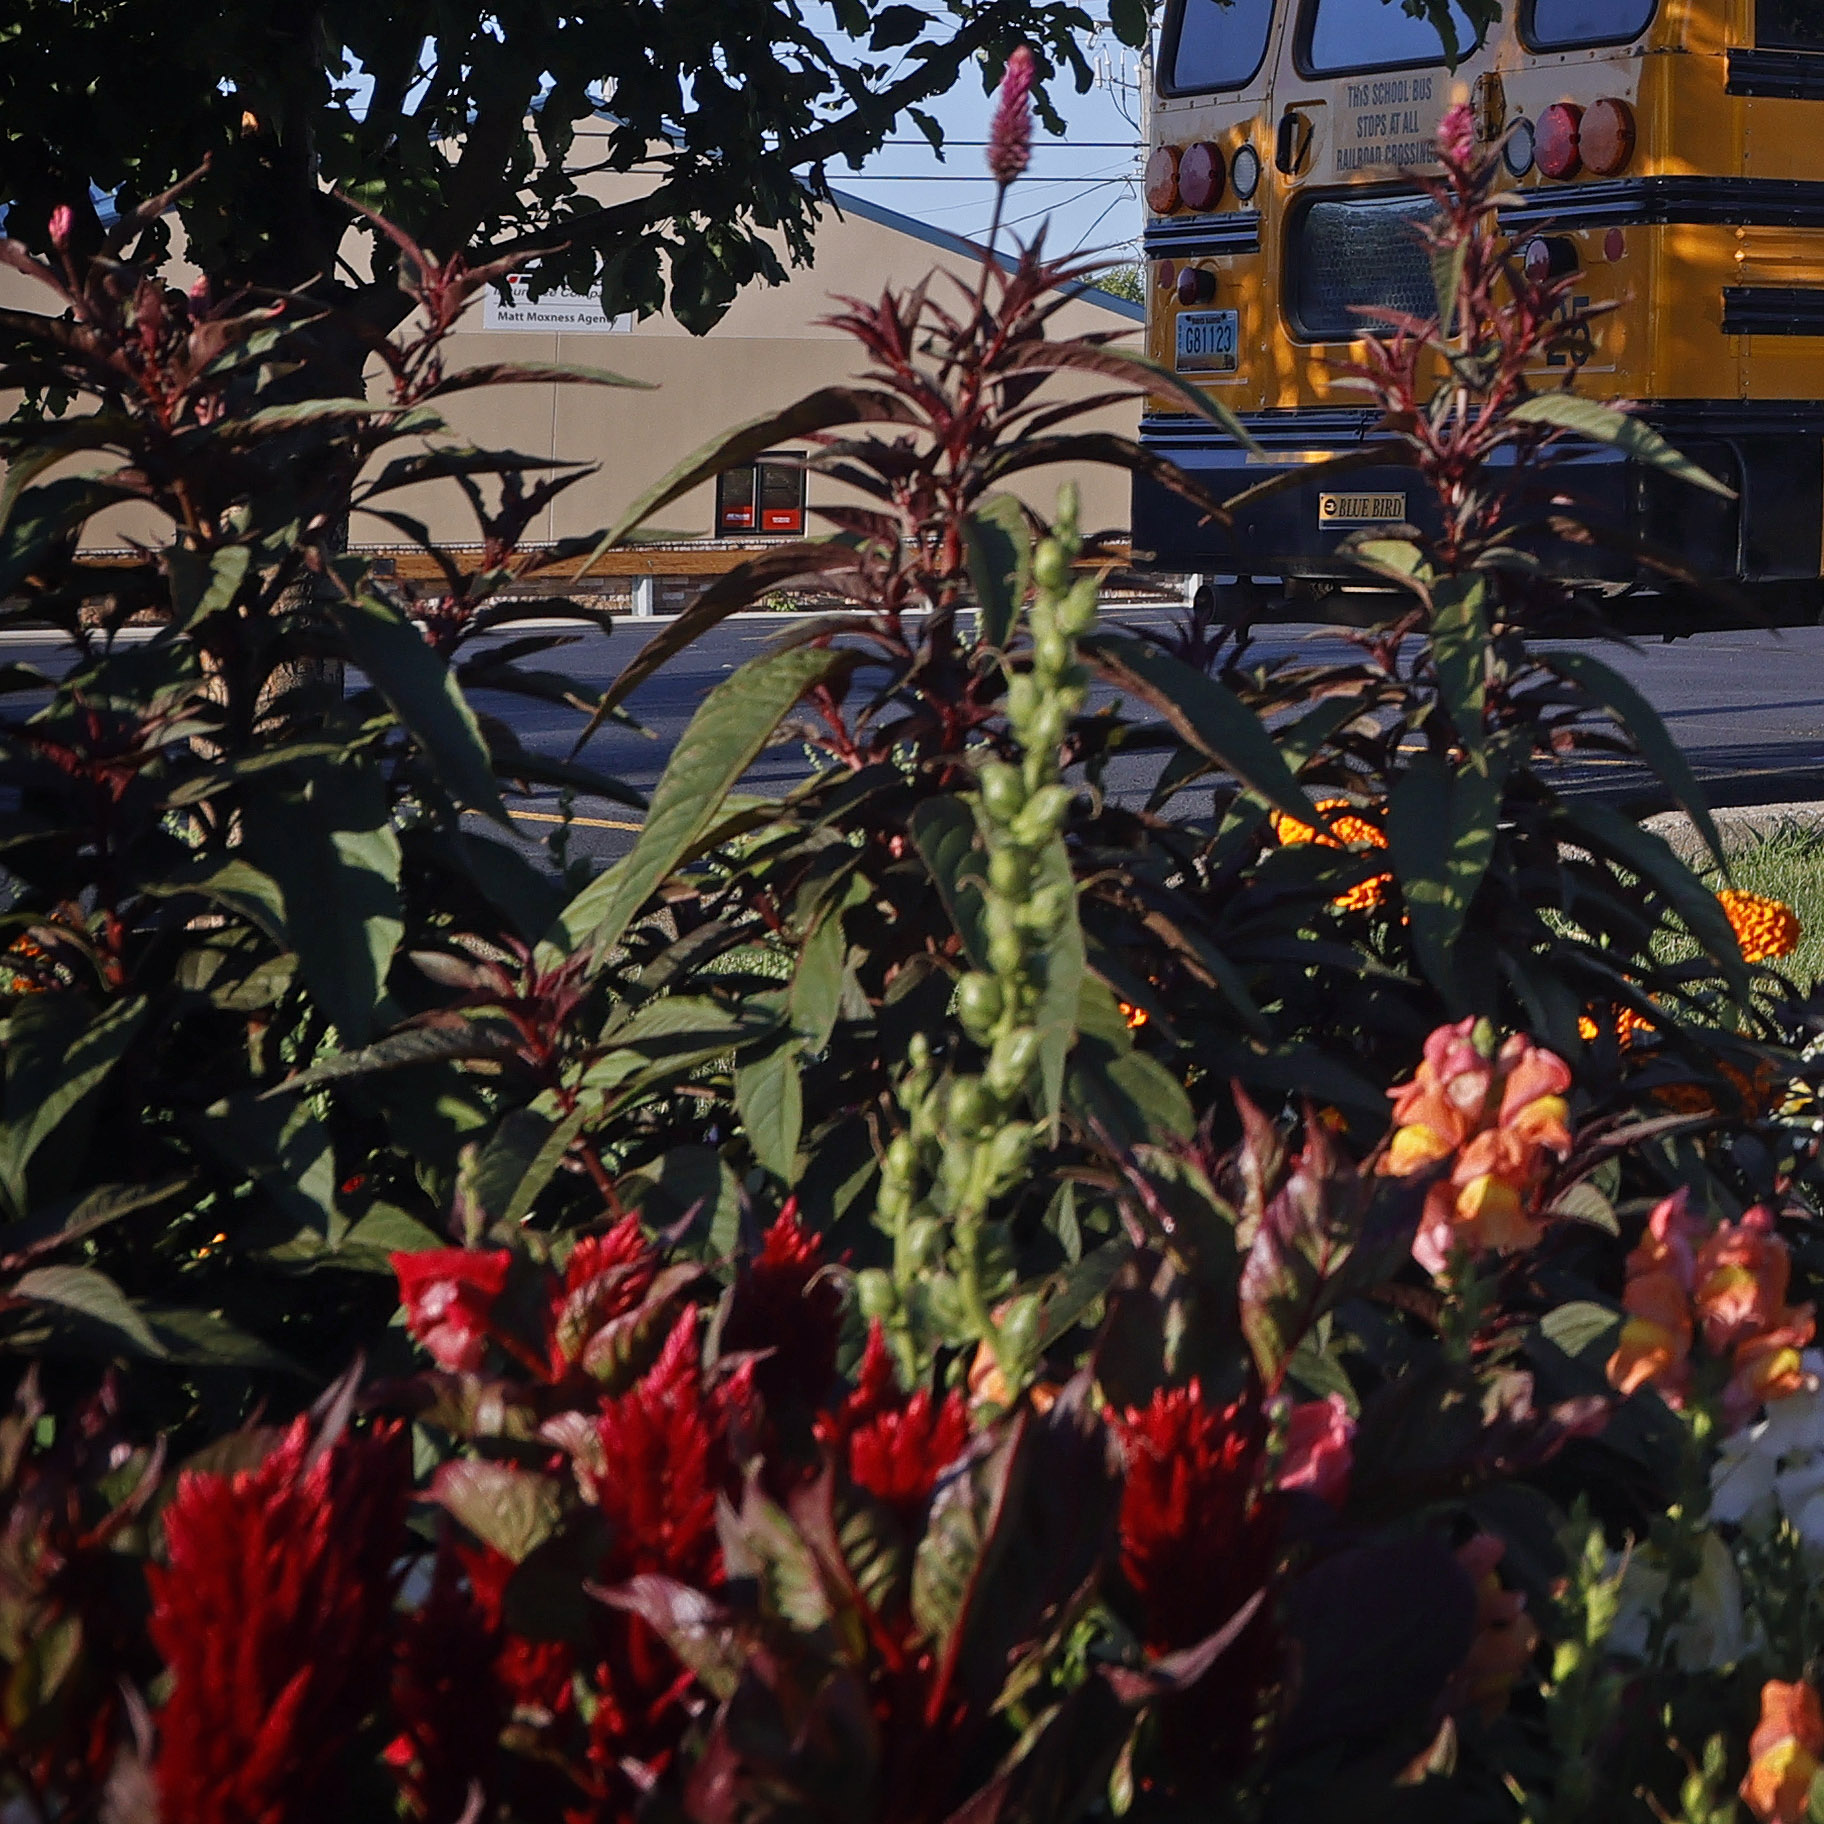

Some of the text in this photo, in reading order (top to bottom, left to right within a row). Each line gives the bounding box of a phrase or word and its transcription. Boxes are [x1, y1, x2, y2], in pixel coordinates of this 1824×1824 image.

[1347, 77, 1432, 108] THIS SCHOOL BUS
[1357, 110, 1419, 138] STOPS AT ALL
[1336, 146, 1381, 171] RAILROAD
[497, 311, 524, 322] Matt
[526, 312, 575, 323] Moxness
[1185, 325, 1232, 354] G81123
[1339, 498, 1402, 518] BLUE BIRD
